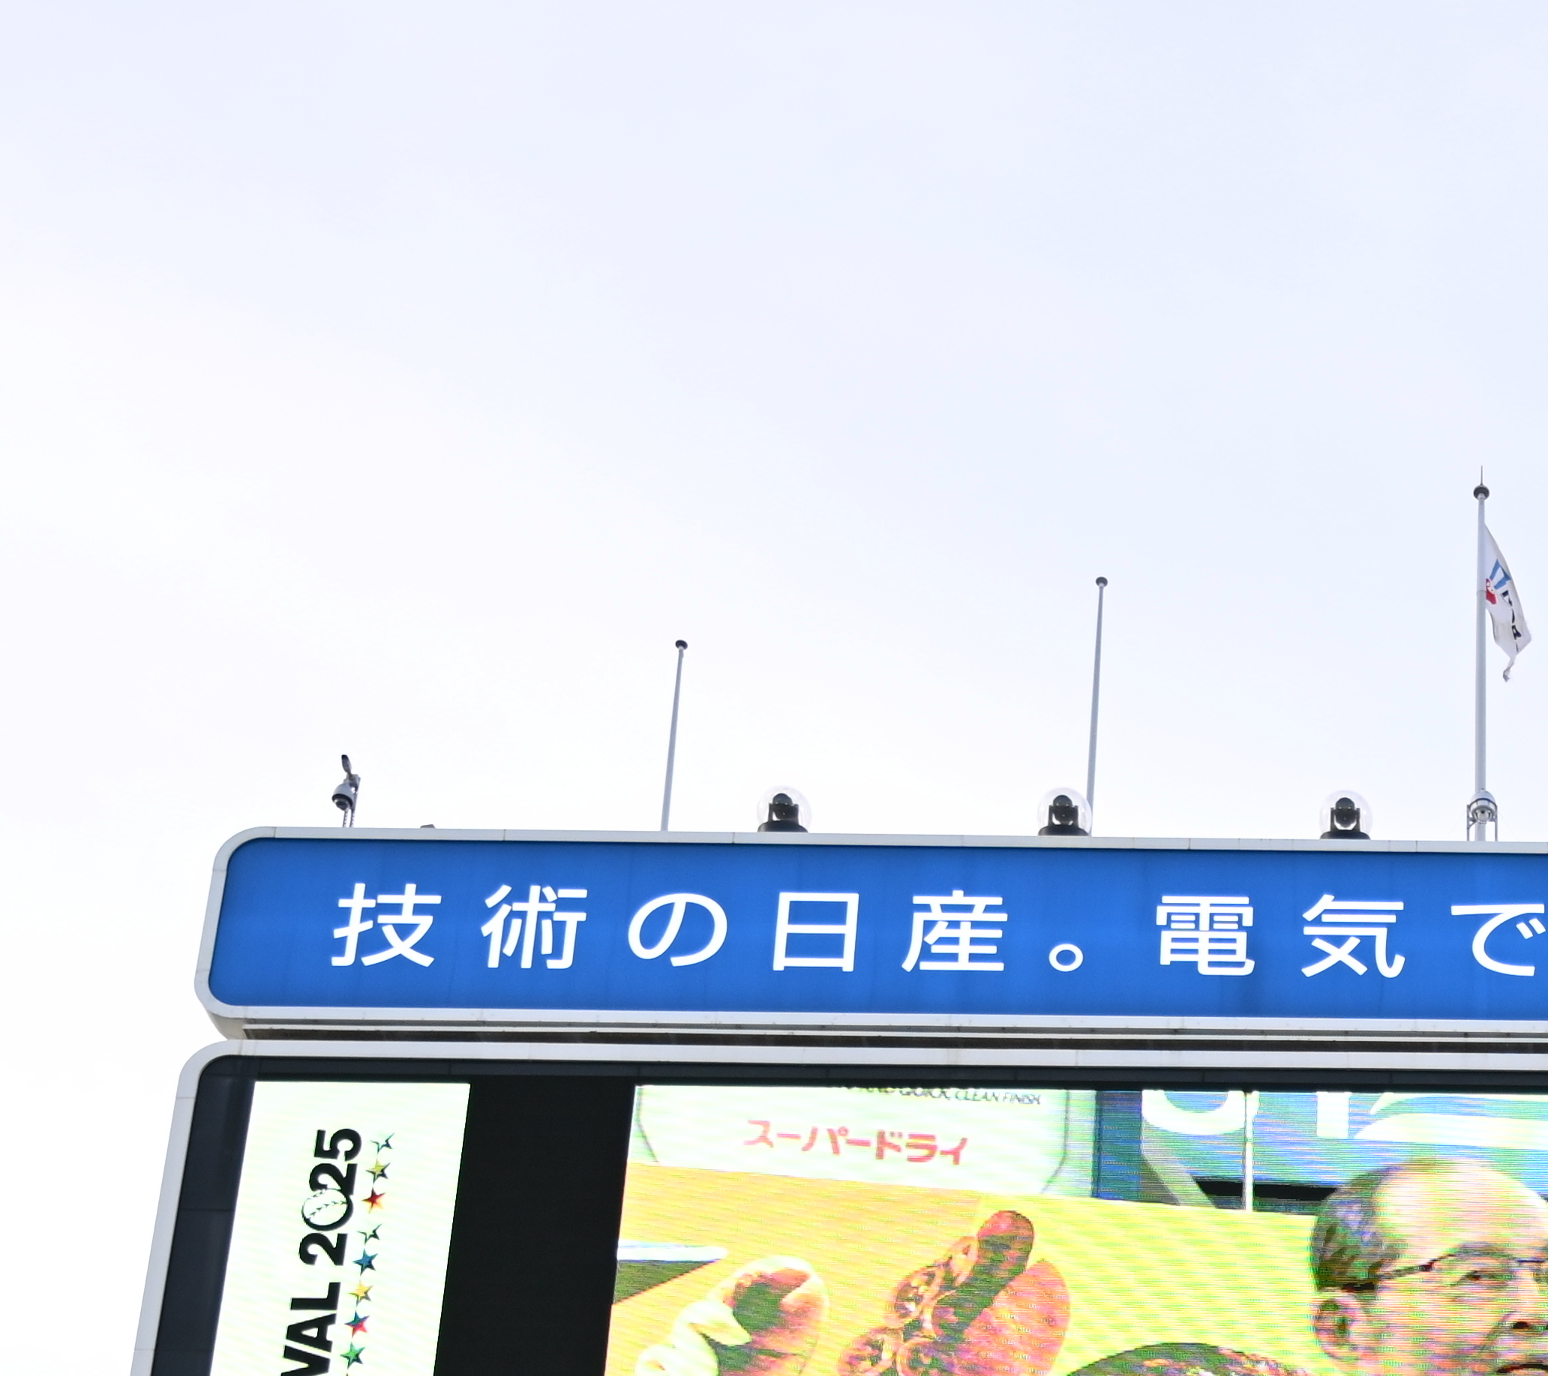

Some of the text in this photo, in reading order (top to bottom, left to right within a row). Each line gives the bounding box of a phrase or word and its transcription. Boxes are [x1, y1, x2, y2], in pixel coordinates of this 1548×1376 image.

[744, 1118, 969, 1167] スーパードライ
[298, 1128, 361, 1266] 2025
